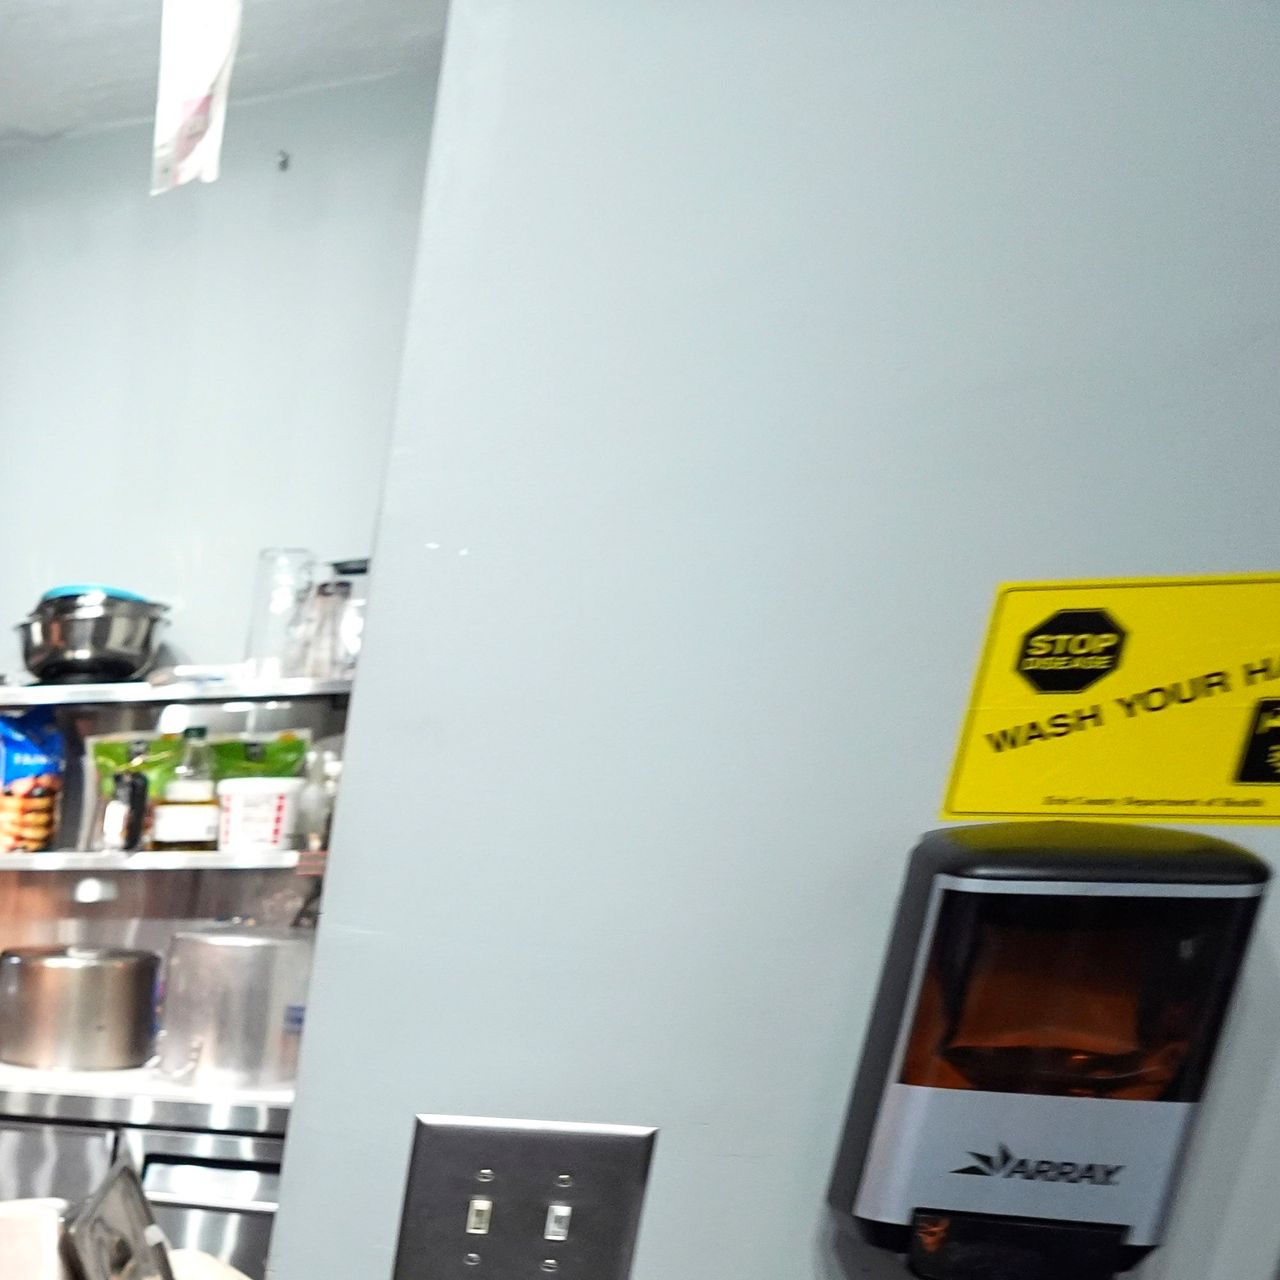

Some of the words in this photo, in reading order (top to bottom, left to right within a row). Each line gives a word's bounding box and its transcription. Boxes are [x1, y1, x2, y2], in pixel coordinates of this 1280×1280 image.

[1028, 633, 1119, 656] STOP
[984, 704, 1104, 753] WASH
[1114, 670, 1233, 718] YOUR
[1004, 1158, 1126, 1186] ARRAY
